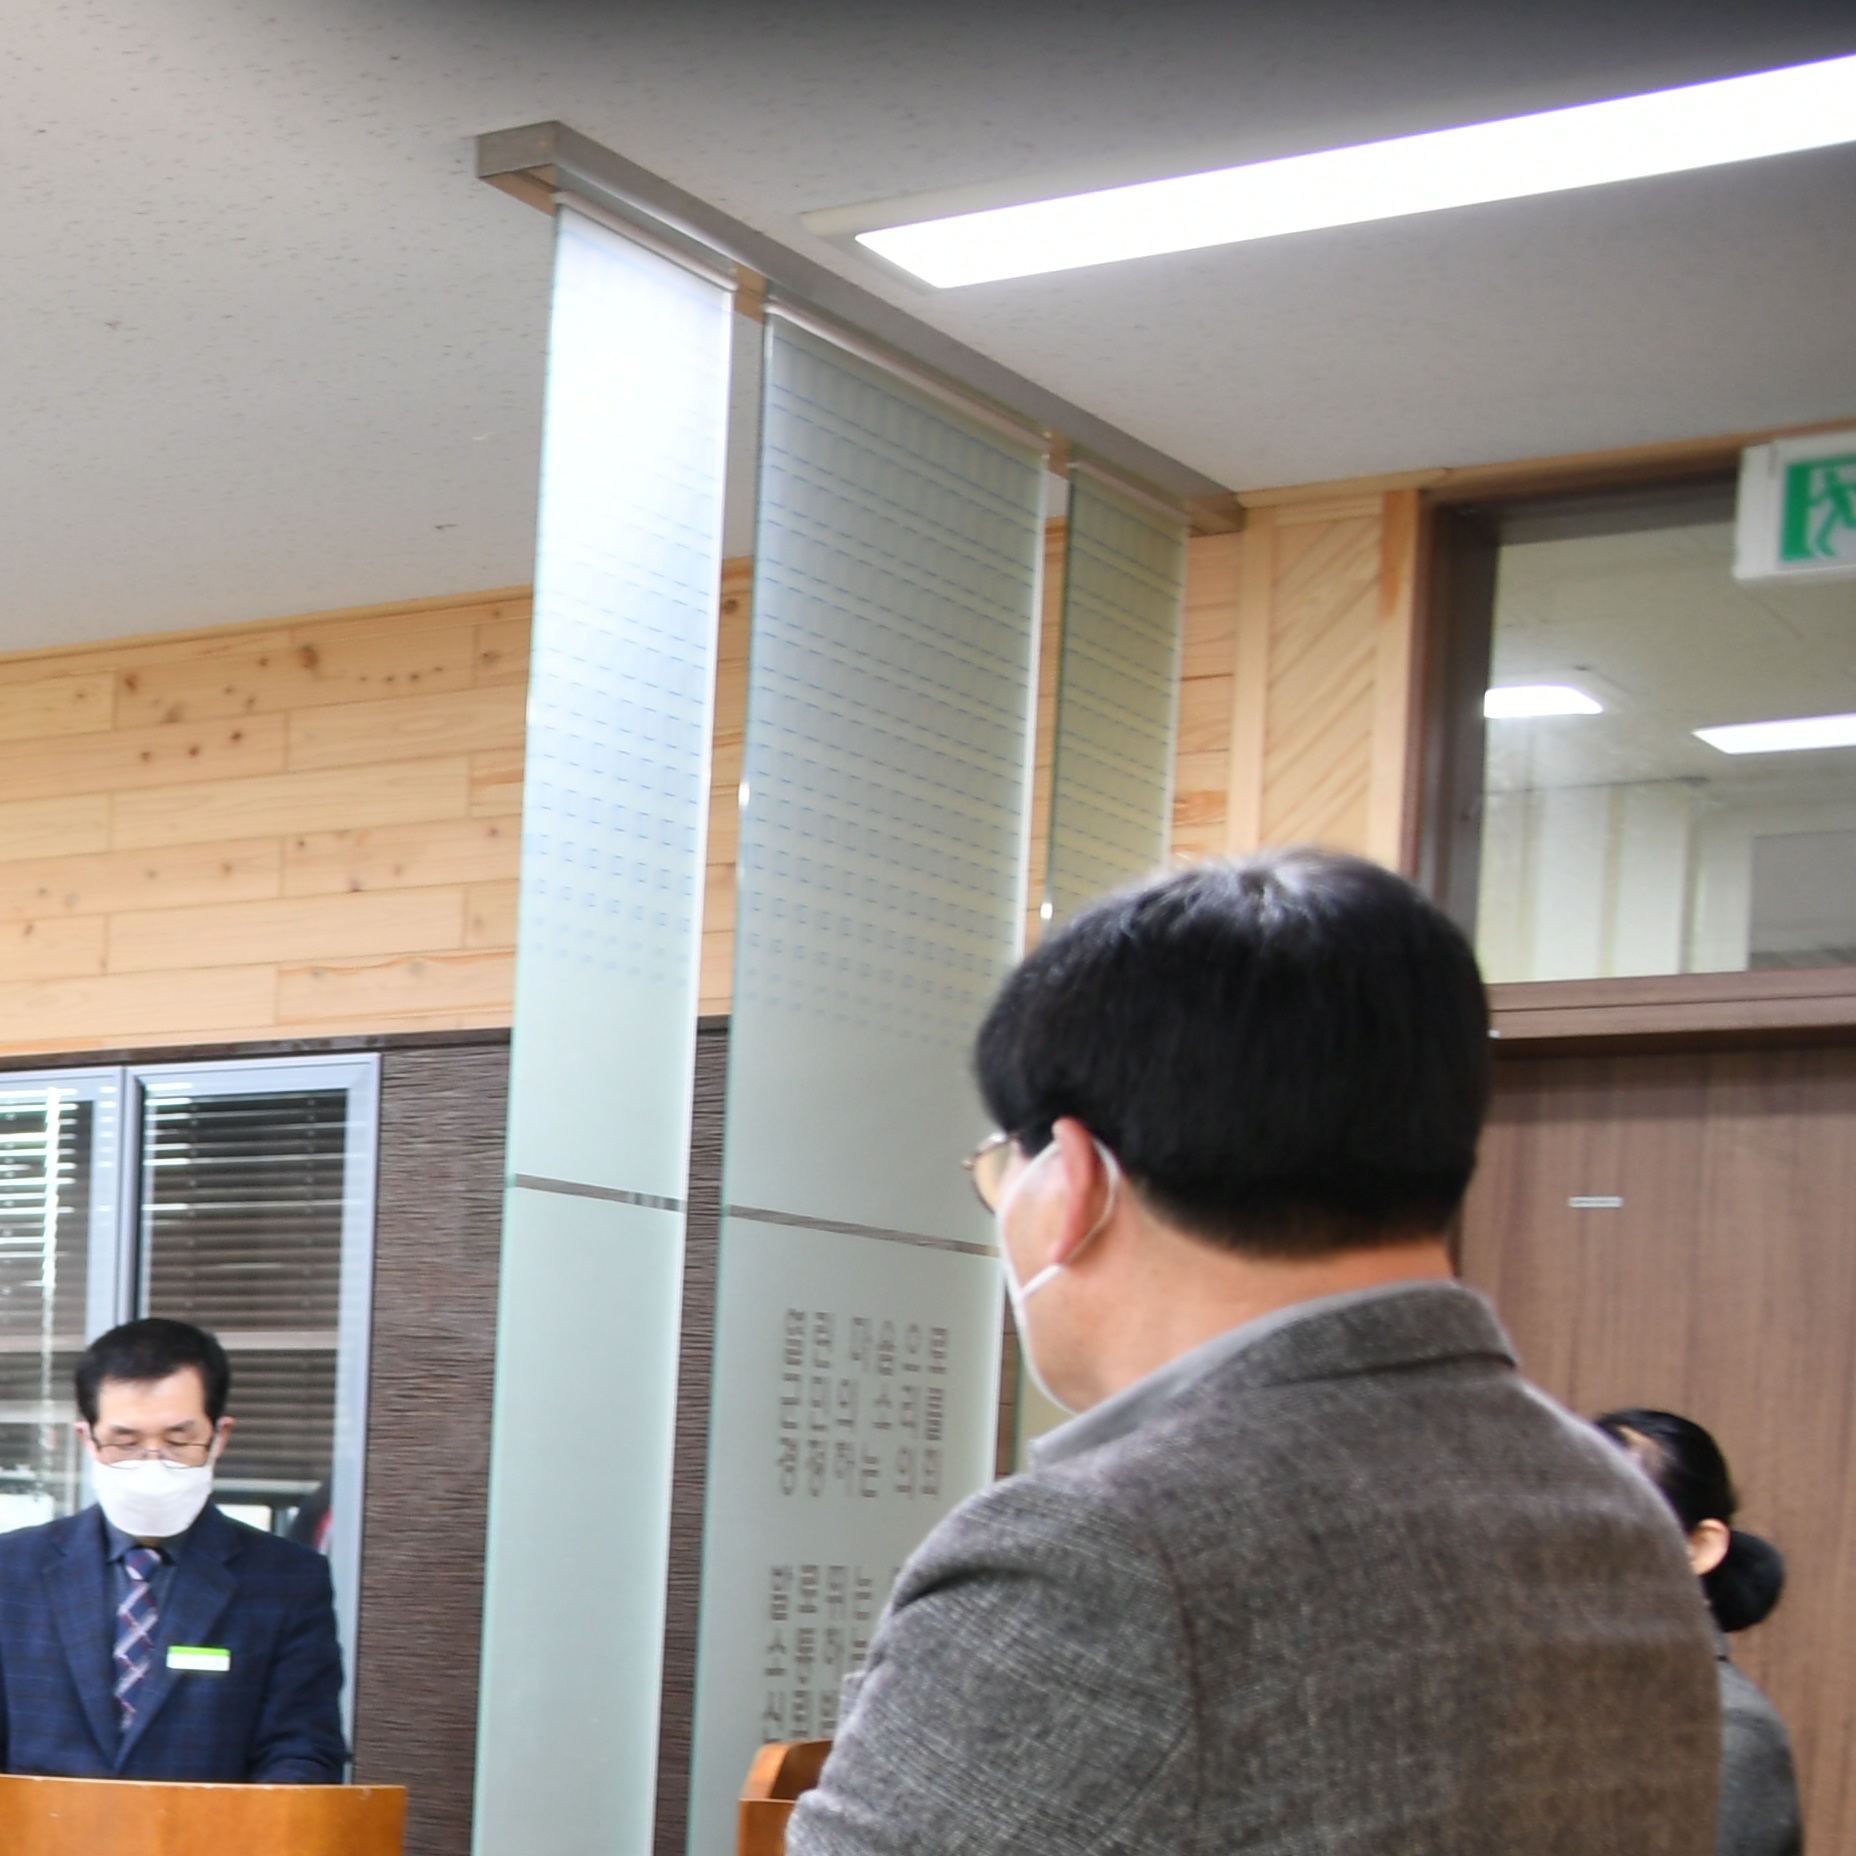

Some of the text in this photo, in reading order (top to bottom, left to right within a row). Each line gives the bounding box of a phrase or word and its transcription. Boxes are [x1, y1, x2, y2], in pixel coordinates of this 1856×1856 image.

[784, 1308, 948, 1378] 열린 마음으로
[780, 1373, 945, 1442] 군민의 소리를
[775, 1437, 945, 1500] 경청하는 의회
[762, 1689, 842, 1744] 신뢰받
